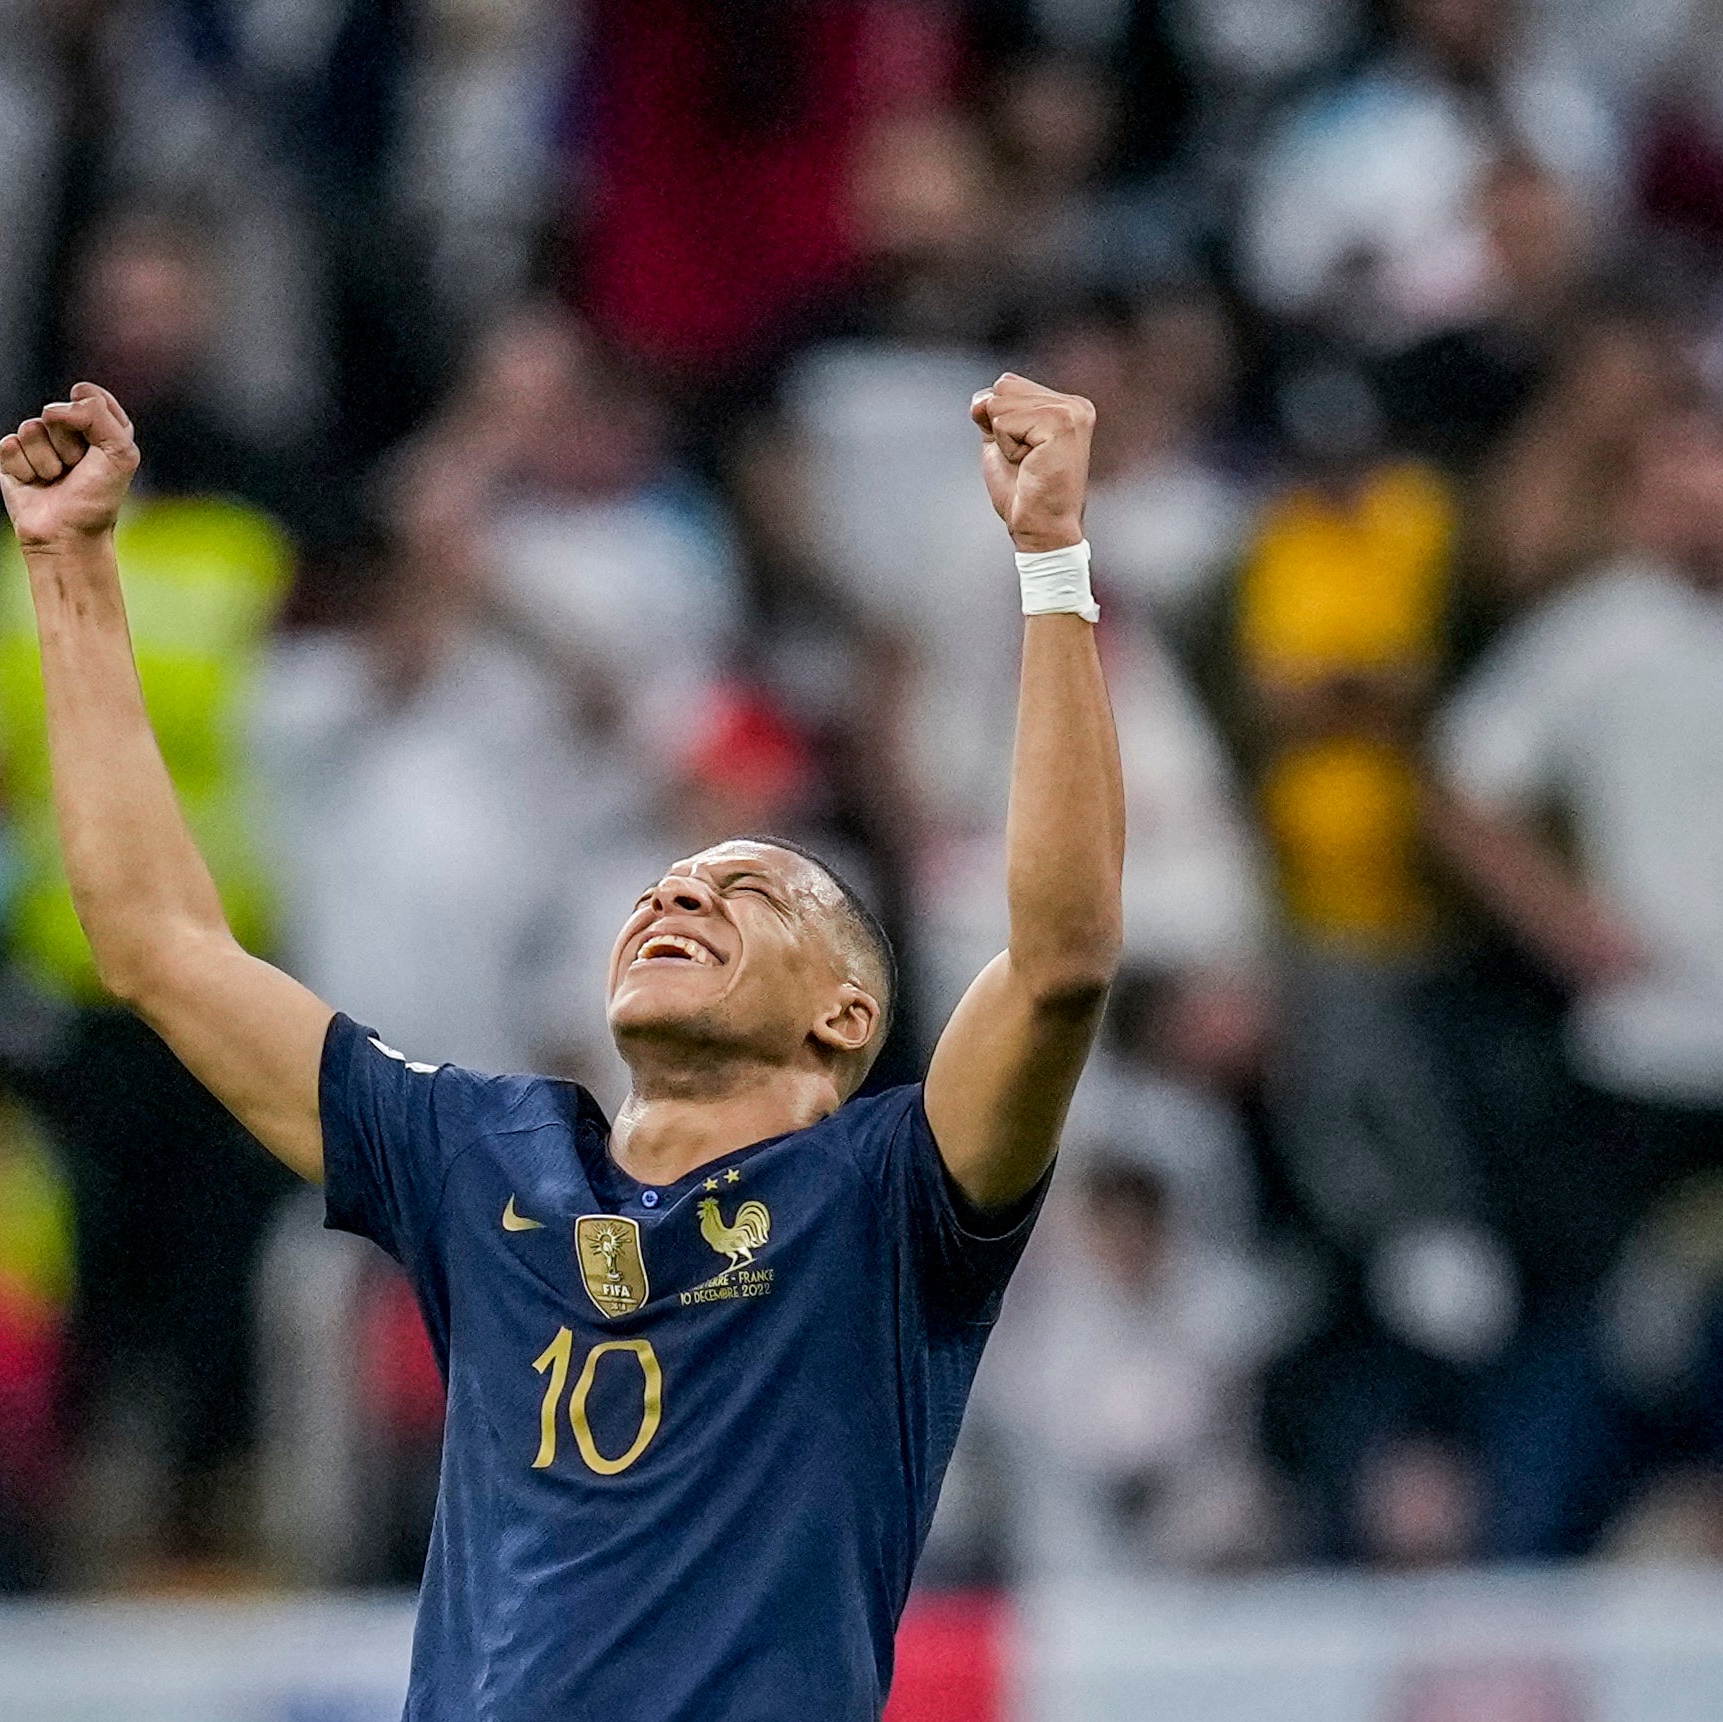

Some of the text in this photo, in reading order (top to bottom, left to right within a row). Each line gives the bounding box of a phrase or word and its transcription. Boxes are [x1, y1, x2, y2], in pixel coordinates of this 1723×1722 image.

[738, 1269, 774, 1283] FRANCE
[603, 1284, 631, 1298] FIFA
[680, 1291, 692, 1306] 10
[741, 1282, 771, 1297] 2022
[531, 1326, 663, 1475] 10
